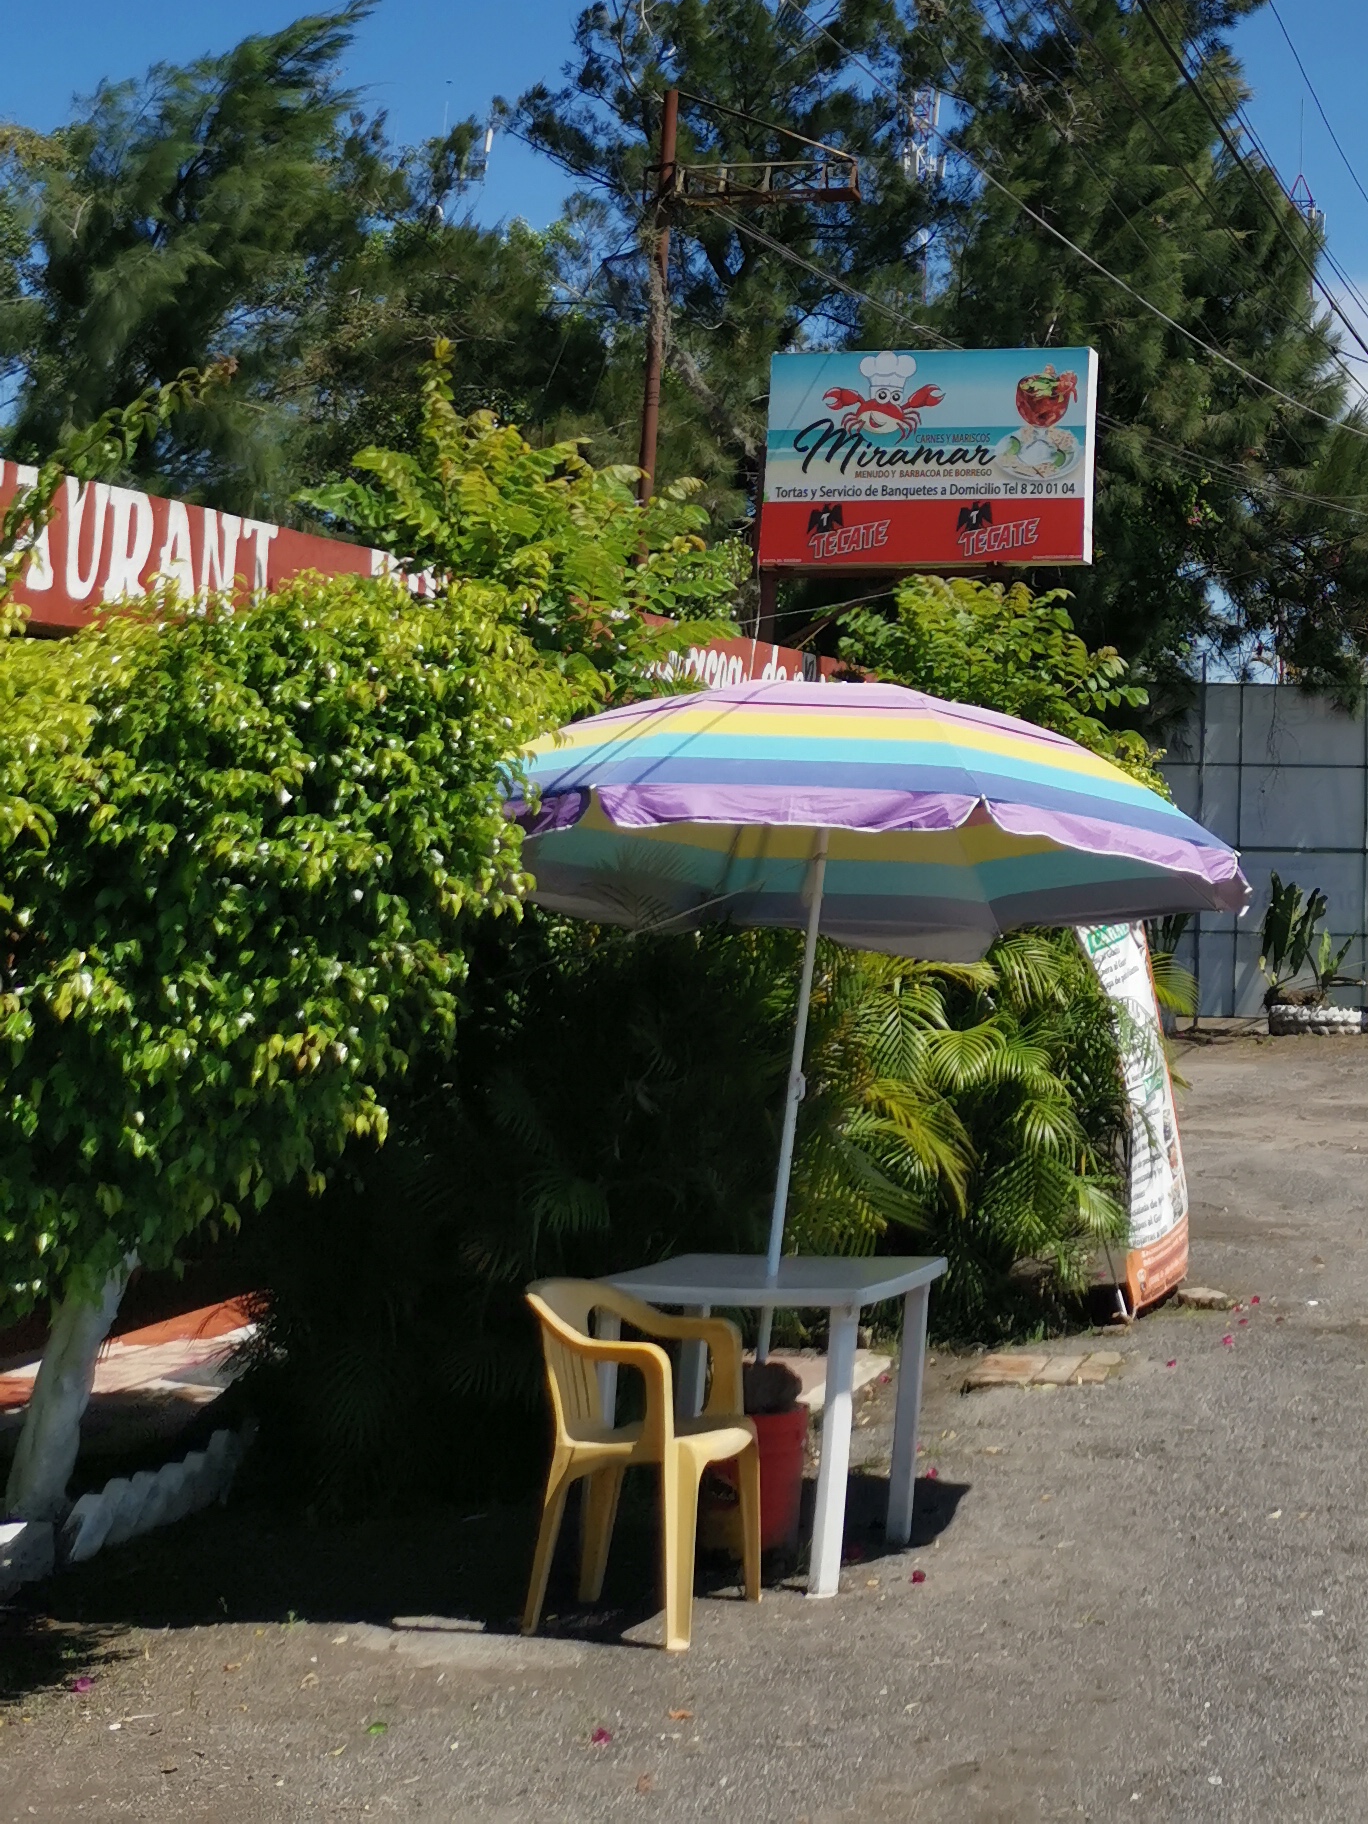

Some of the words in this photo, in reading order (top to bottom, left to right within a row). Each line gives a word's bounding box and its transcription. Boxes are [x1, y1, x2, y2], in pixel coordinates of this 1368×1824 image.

[793, 418, 996, 475] Miramar
[915, 434, 945, 444] CARNES
[945, 434, 951, 443] Y
[952, 433, 991, 443] MARISCOS
[855, 470, 890, 478] MENUDO
[890, 470, 896, 478] Y
[899, 469, 941, 478] BARBACOA
[943, 469, 954, 477] DE
[955, 468, 992, 477] BORREGO
[775, 486, 808, 498] Tortas
[810, 489, 817, 500] y
[819, 485, 863, 497] Servicio
[865, 484, 879, 496] de
[881, 484, 938, 499] Banquetes
[940, 487, 947, 496] a
[949, 482, 1000, 495] Domicilio
[1003, 483, 1018, 495] Tel
[1021, 483, 1027, 494] 8
[1030, 483, 1043, 494] 20
[1046, 483, 1058, 494] 01
[1061, 482, 1075, 494] 04
[808, 519, 891, 559] TECATE
[957, 517, 1041, 557] TECATE
